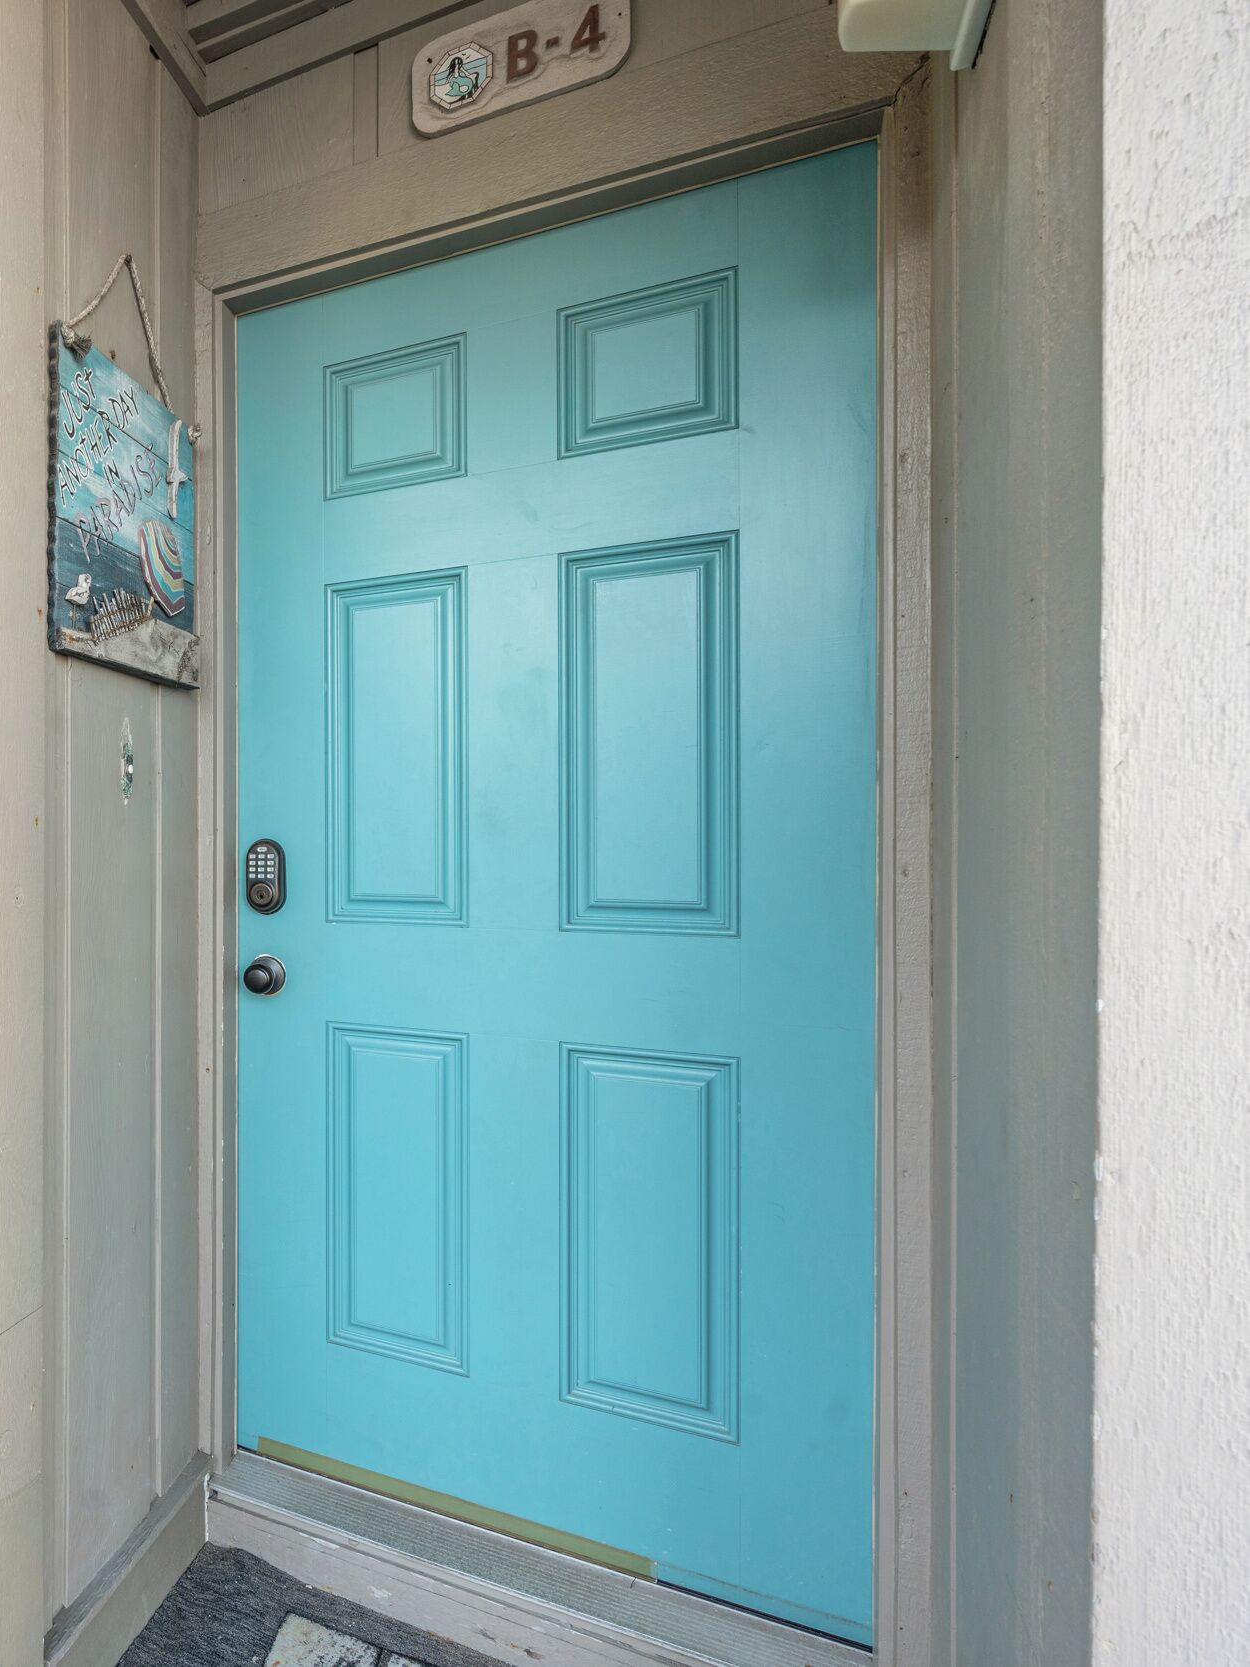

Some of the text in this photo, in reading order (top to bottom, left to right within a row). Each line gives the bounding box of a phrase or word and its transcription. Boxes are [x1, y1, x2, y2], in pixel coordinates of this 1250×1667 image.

[506, 4, 606, 84] B-4
[108, 387, 139, 431] DAY
[74, 443, 162, 564] PARADISE
[103, 459, 119, 491] IN
